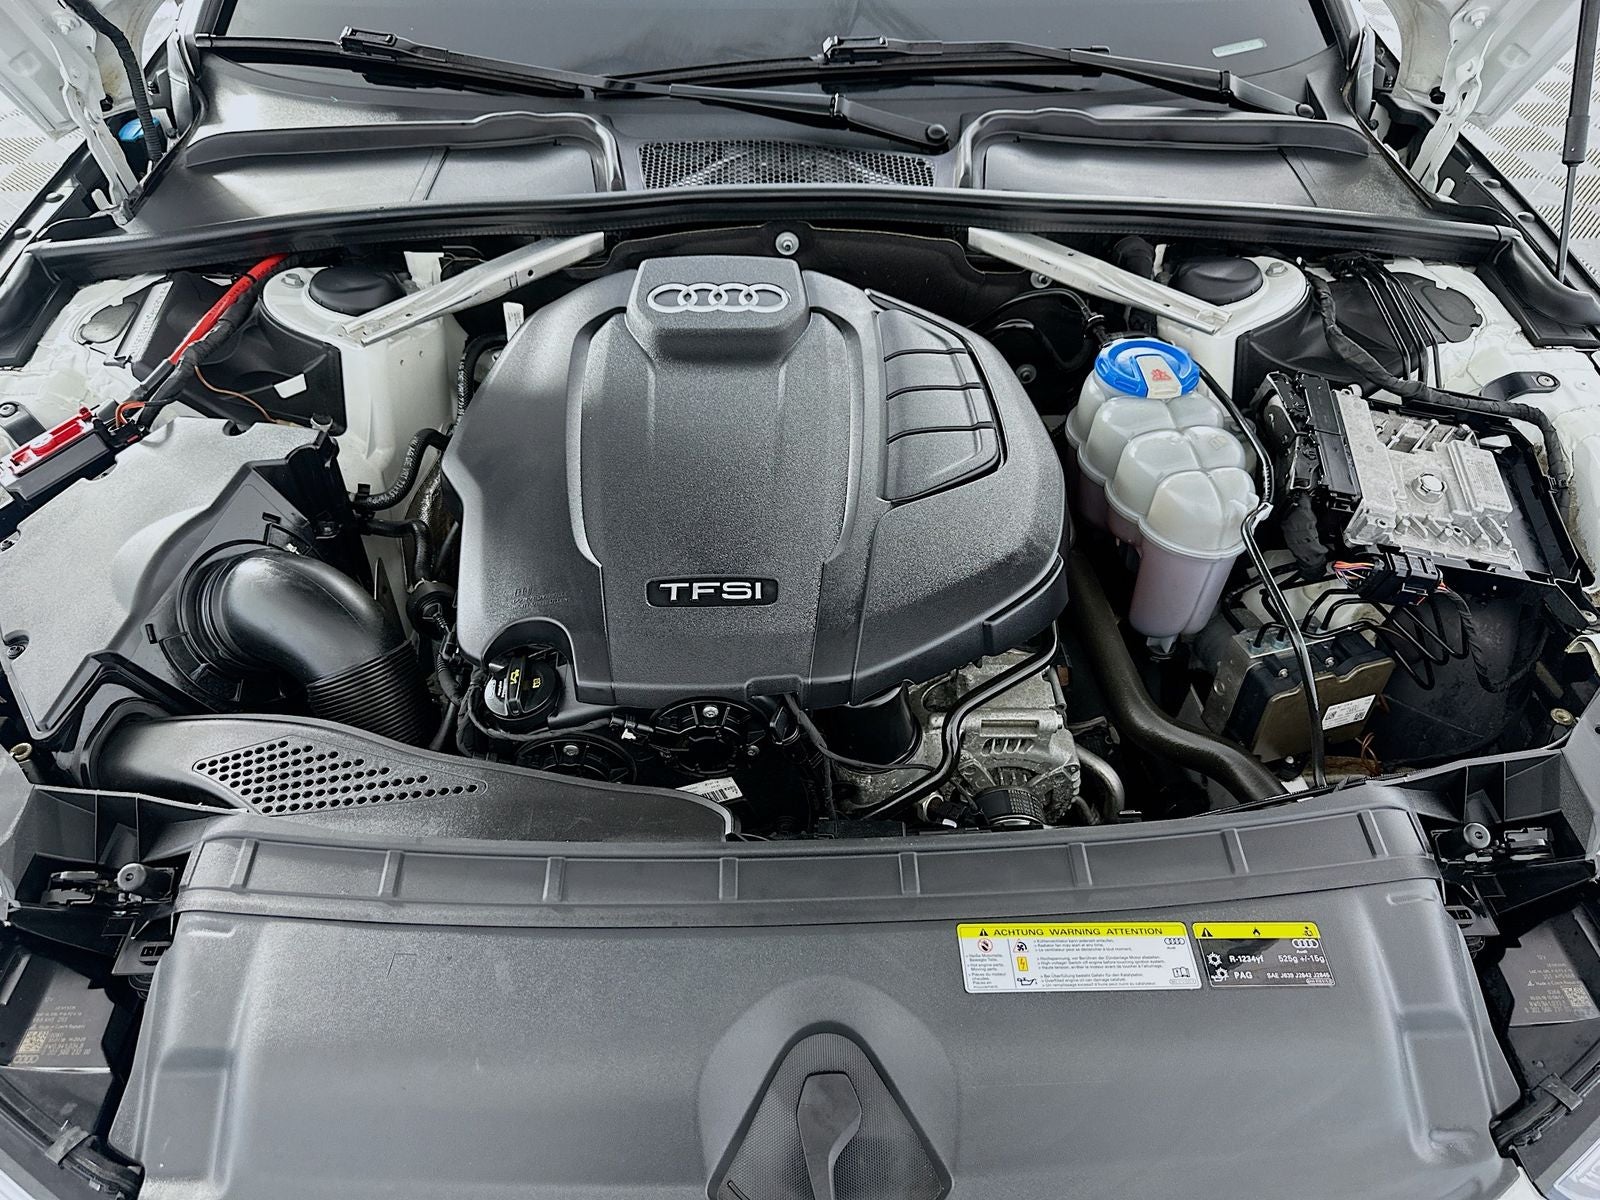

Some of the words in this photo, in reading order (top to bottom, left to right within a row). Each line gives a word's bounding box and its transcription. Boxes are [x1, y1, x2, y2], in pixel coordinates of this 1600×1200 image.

[659, 581, 762, 601] TFSI
[1229, 955, 1264, 964] R-1234yf
[1278, 955, 1298, 964] 525g
